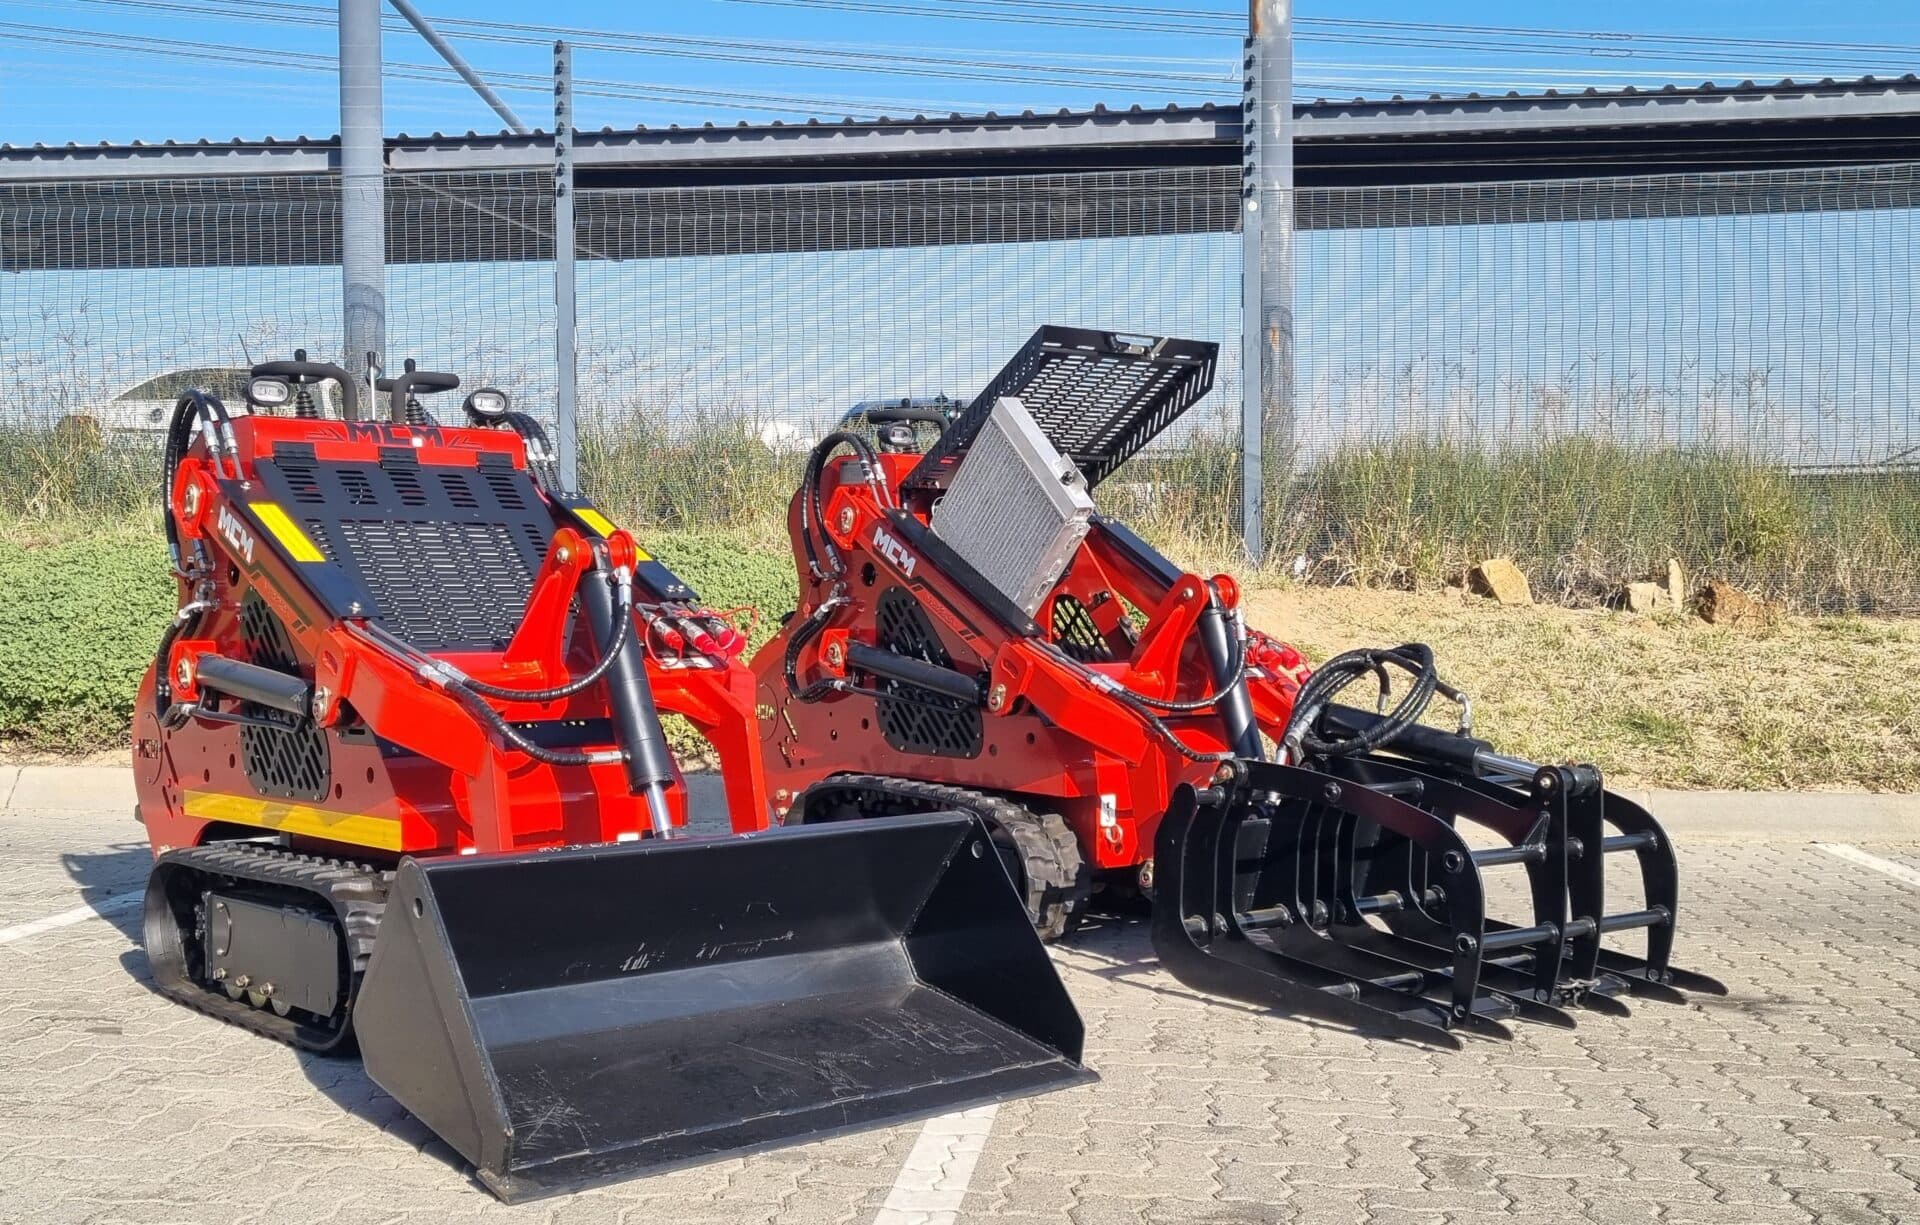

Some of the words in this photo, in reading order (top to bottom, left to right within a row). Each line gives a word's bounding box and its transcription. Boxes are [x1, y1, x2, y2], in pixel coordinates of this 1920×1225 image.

[347, 423, 444, 448] MCM
[218, 505, 254, 564] MCM
[873, 526, 916, 578] MCM
